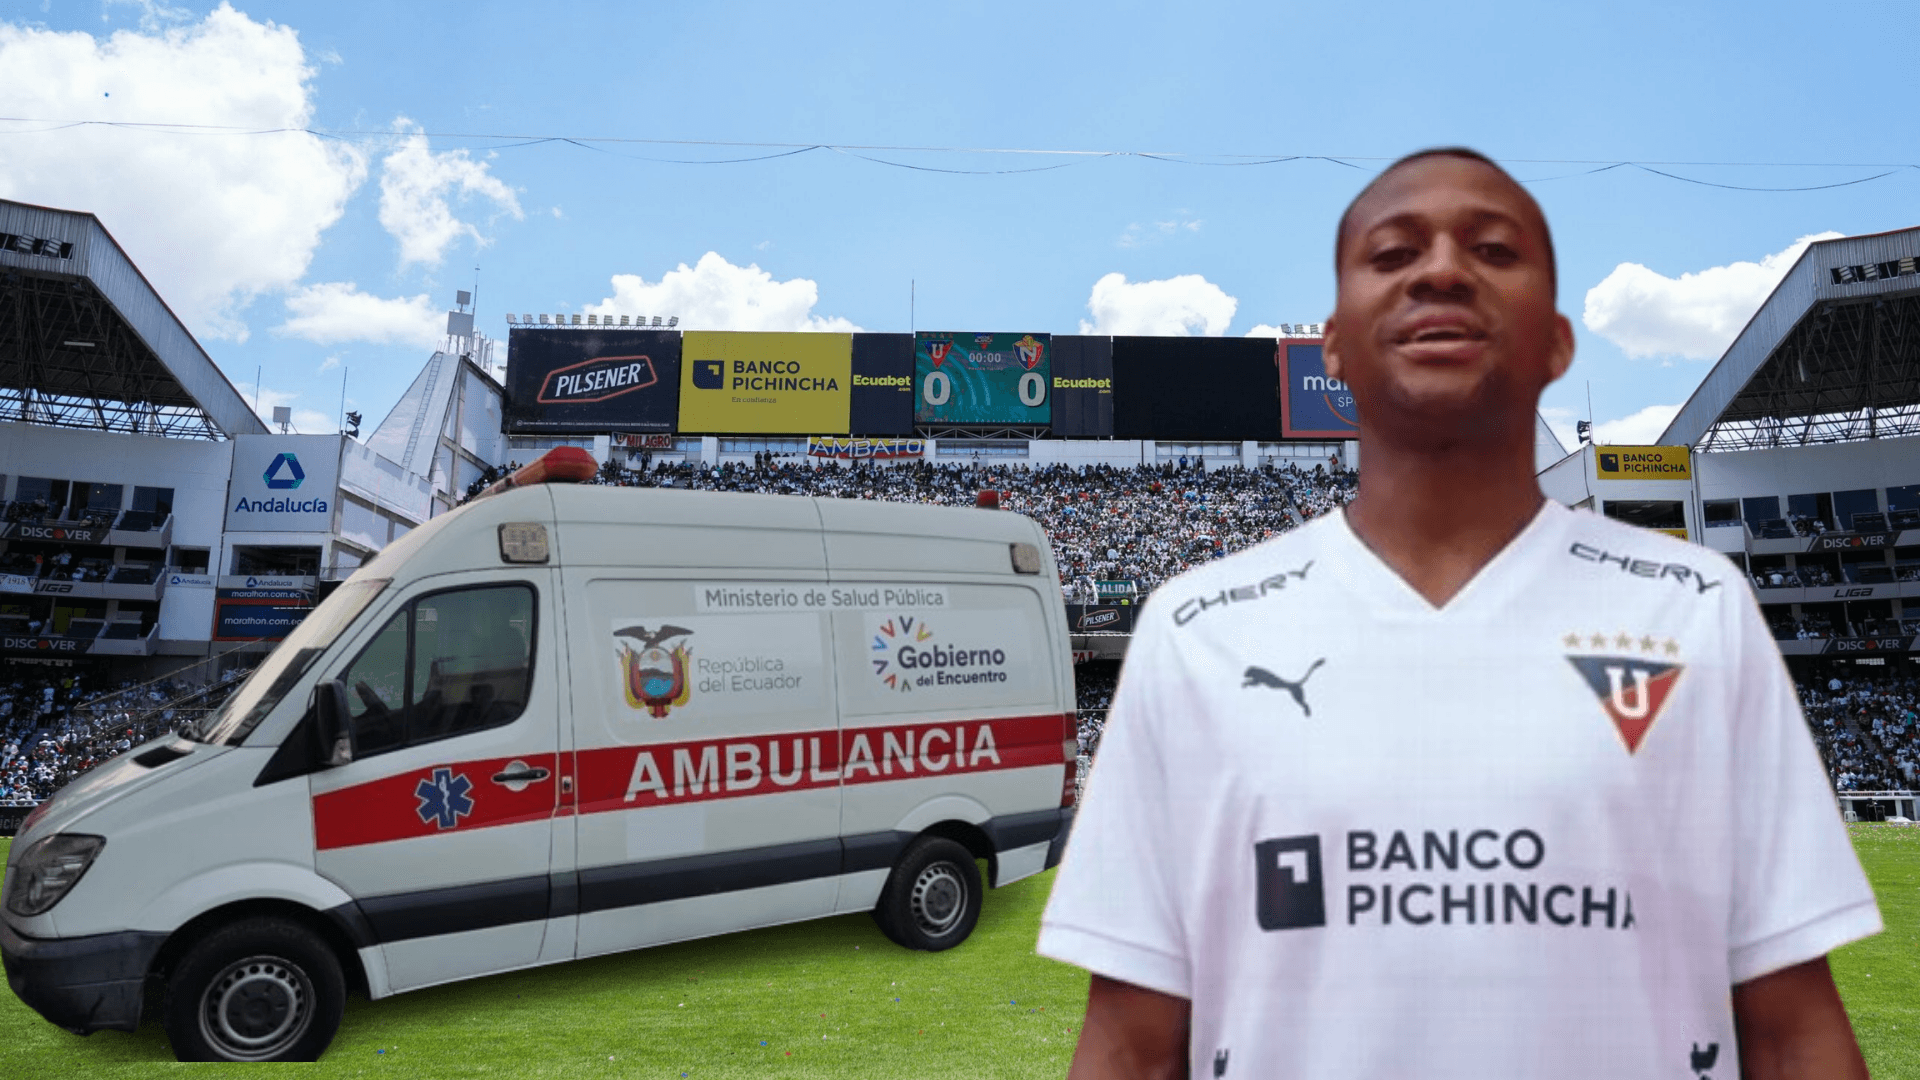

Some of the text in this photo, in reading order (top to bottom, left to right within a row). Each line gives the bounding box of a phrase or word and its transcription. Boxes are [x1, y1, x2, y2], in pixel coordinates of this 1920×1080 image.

[968, 352, 1002, 363] 00:00
[733, 360, 801, 374] BANCO
[555, 363, 641, 397] PILSENER
[732, 377, 839, 391] PICHINCHA
[853, 374, 911, 386] Ecuabet
[1053, 377, 1111, 388] Ecuabet
[923, 371, 951, 406] 0
[1018, 372, 1046, 407] 0
[811, 440, 923, 458] AMBATO
[1623, 454, 1663, 462] BANCO
[1623, 463, 1687, 473] PICHINCHA
[234, 497, 328, 513] Andalucía
[21, 526, 92, 541] DISCOVER
[1823, 535, 1885, 548] DISCOVER
[1569, 542, 1722, 594] CHERY
[1095, 583, 1133, 594] SALIDA
[1172, 559, 1316, 627] CHERY
[705, 588, 944, 607] Ministerio de Salud Pública
[1085, 612, 1115, 625] PILSENER
[4, 638, 77, 651] DISCOVER
[1837, 639, 1900, 651] DISCOVER
[897, 643, 1005, 669] Gobierno
[698, 656, 784, 677] República
[698, 674, 802, 693] del Ecuador
[916, 670, 1007, 686] del Encuentro
[1605, 666, 1650, 721] U
[623, 723, 1001, 802] AMBULANCIA
[1347, 829, 1545, 871] BANCO
